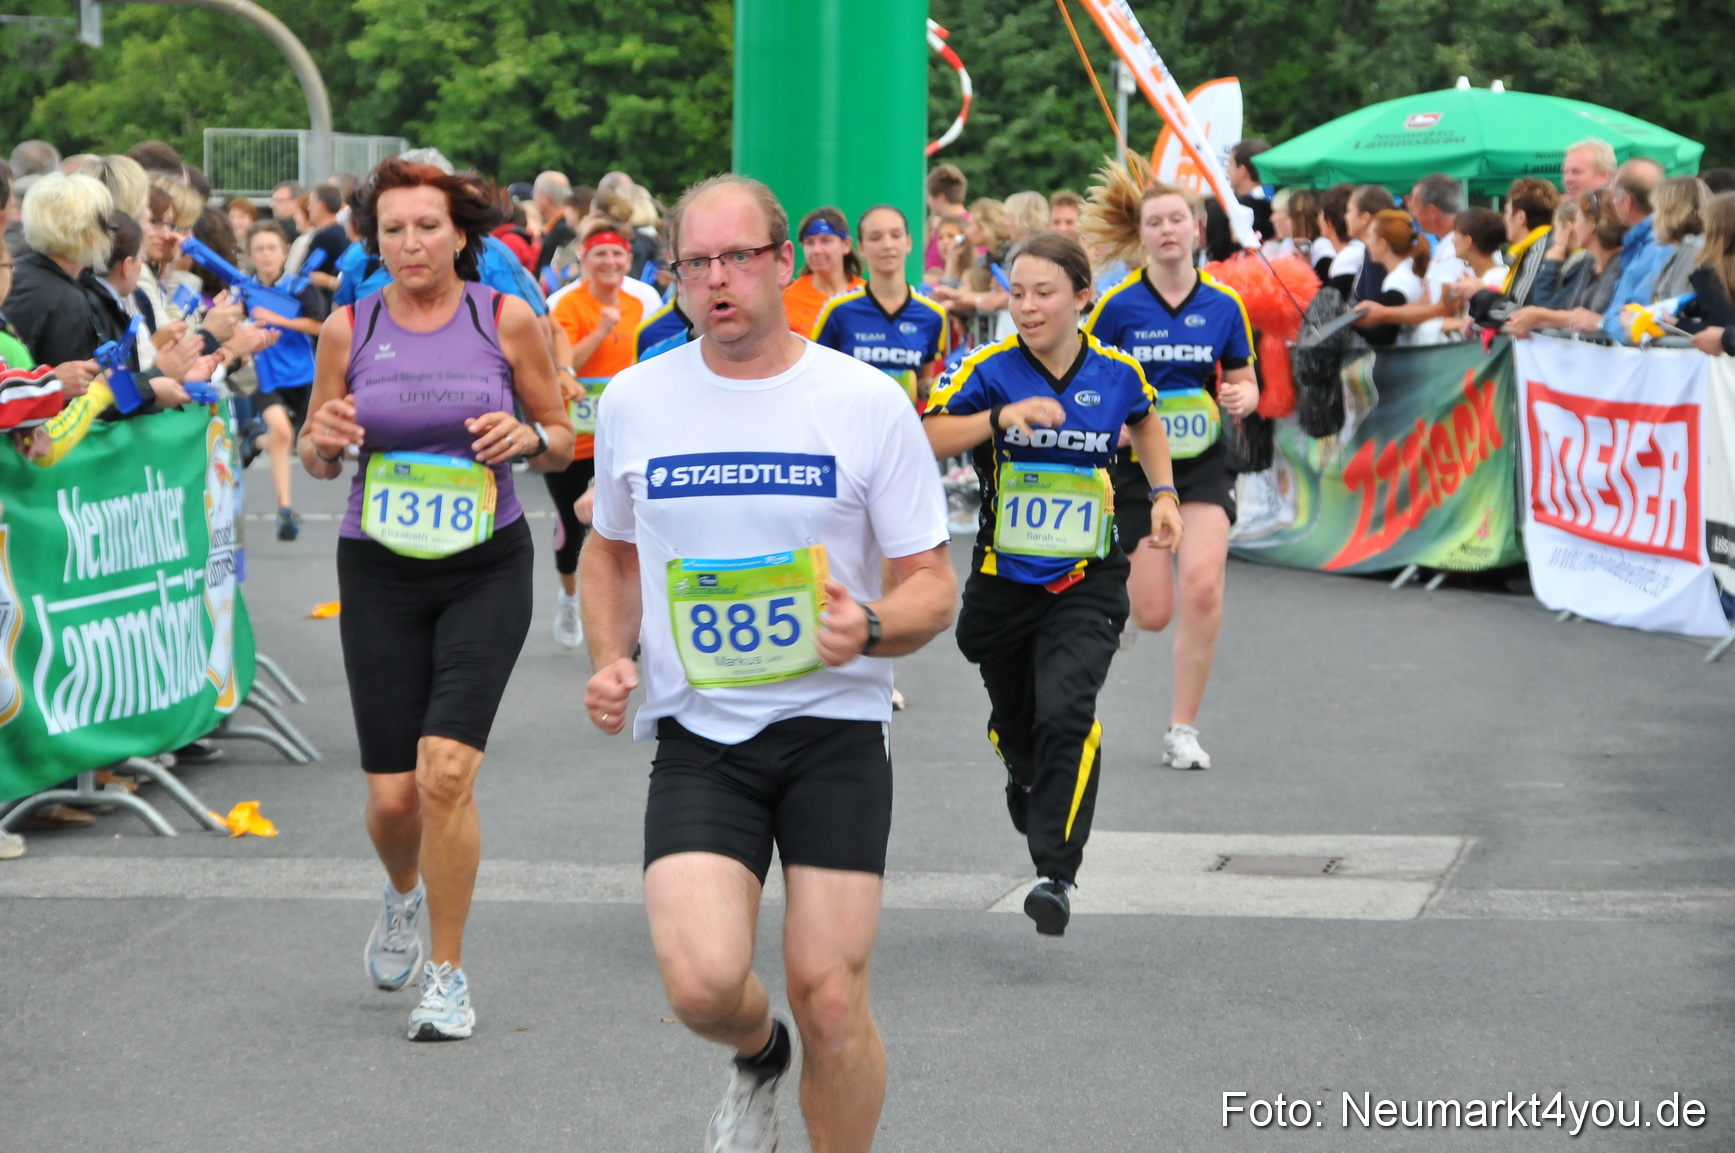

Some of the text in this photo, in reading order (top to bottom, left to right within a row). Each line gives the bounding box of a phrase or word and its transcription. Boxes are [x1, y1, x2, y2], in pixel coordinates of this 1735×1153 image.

[854, 332, 886, 342] TEAM
[1134, 329, 1169, 339] TEAM
[853, 346, 922, 366] BOCK
[1132, 344, 1214, 363] BOCK
[1004, 424, 1111, 453] BOCK
[671, 464, 824, 487] STAEDTLER
[1532, 400, 1688, 550] MEIER
[372, 487, 474, 532] 1318
[1005, 496, 1092, 532] 1071
[57, 466, 189, 583] Neumarkter
[1026, 531, 1053, 542] Sarah
[690, 597, 801, 654] 885
[32, 567, 208, 735] Lammsbräu
